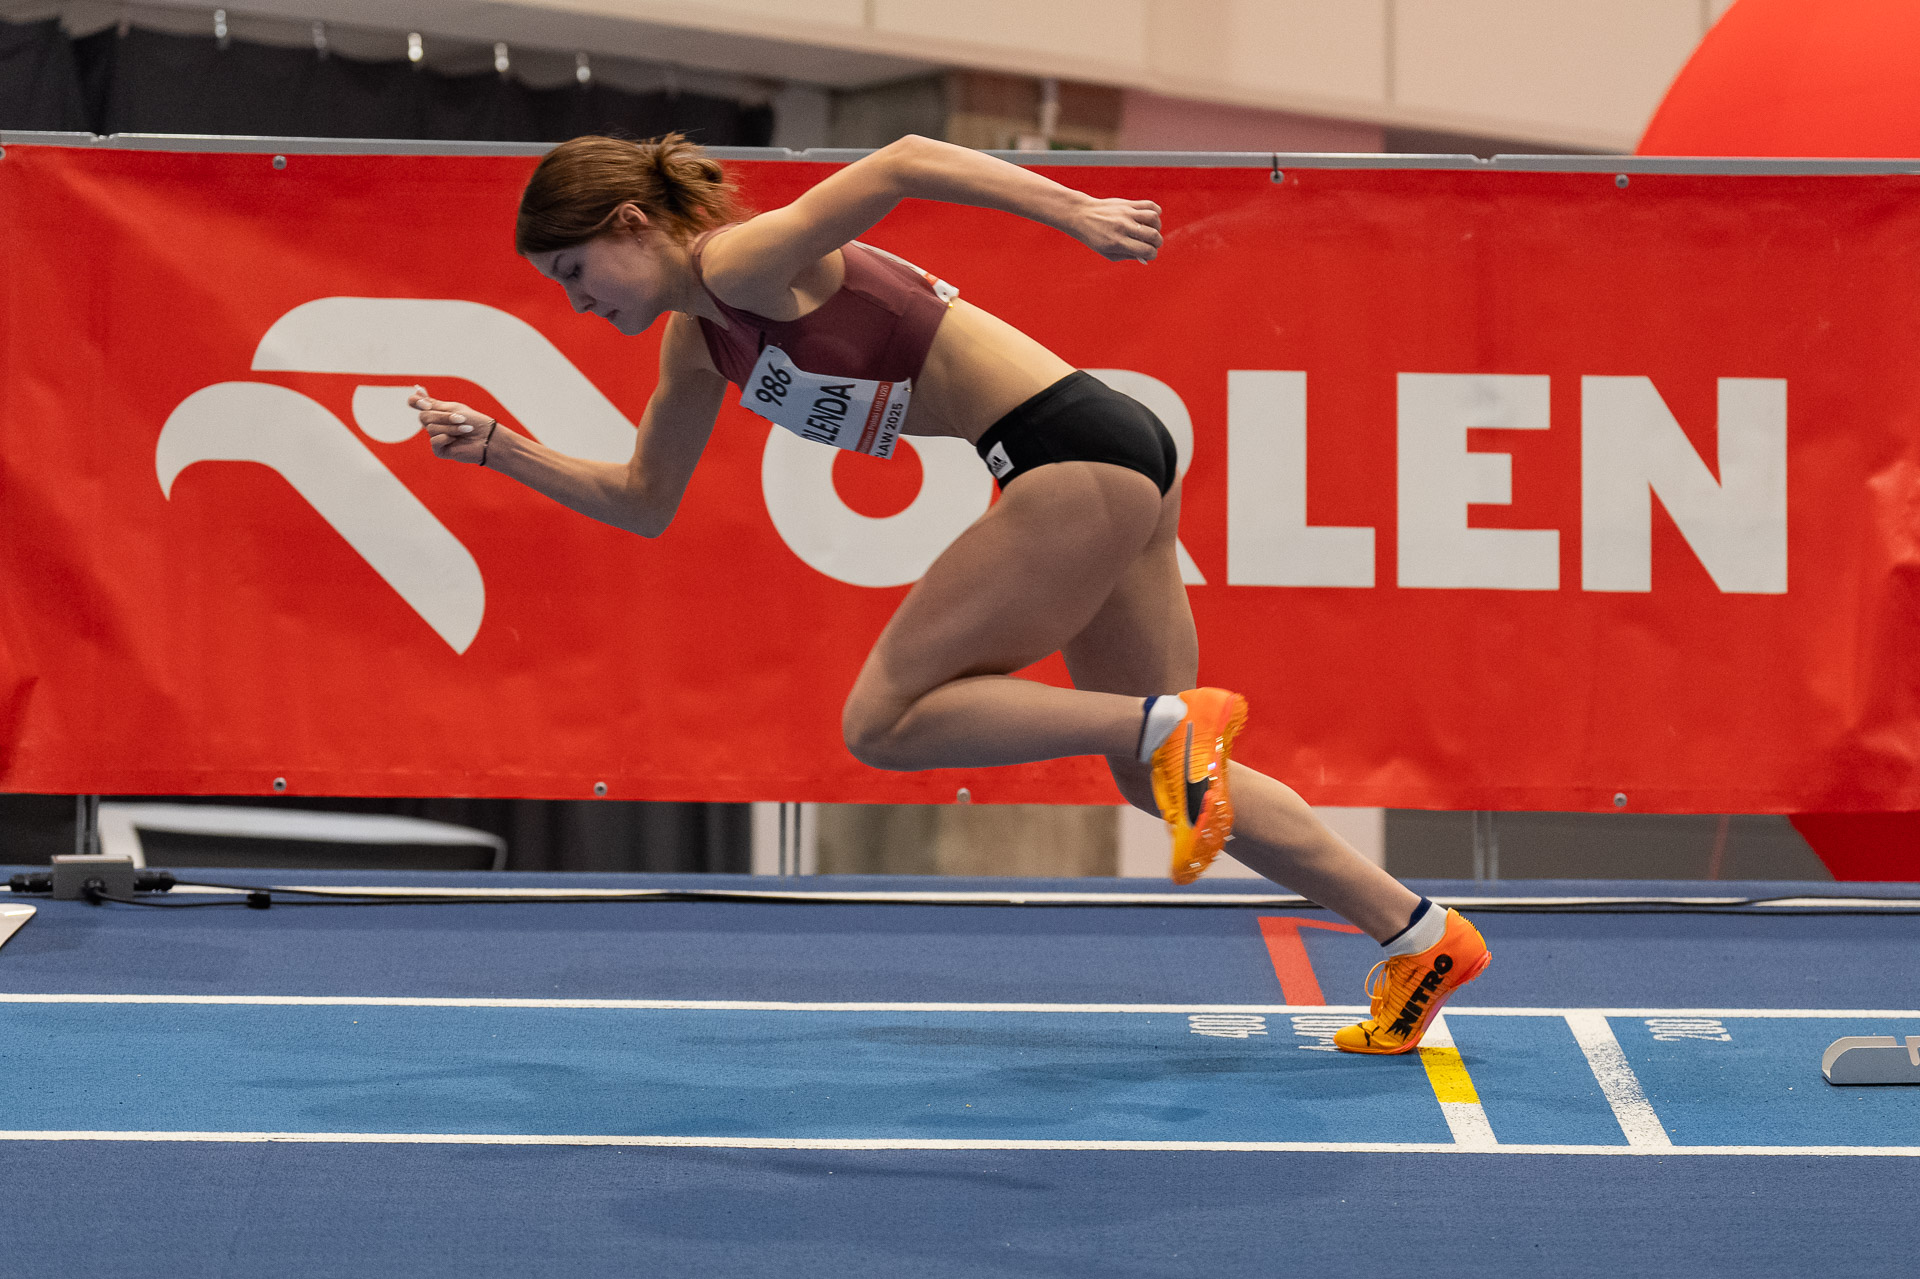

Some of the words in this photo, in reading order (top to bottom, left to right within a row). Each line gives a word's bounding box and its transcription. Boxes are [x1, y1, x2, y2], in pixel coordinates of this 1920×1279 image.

[755, 361, 792, 407] 986
[885, 403, 904, 431] 2025
[1384, 953, 1454, 1043] NITRO
[1187, 1014, 1269, 1039] 400
[1644, 1018, 1733, 1042] 200
